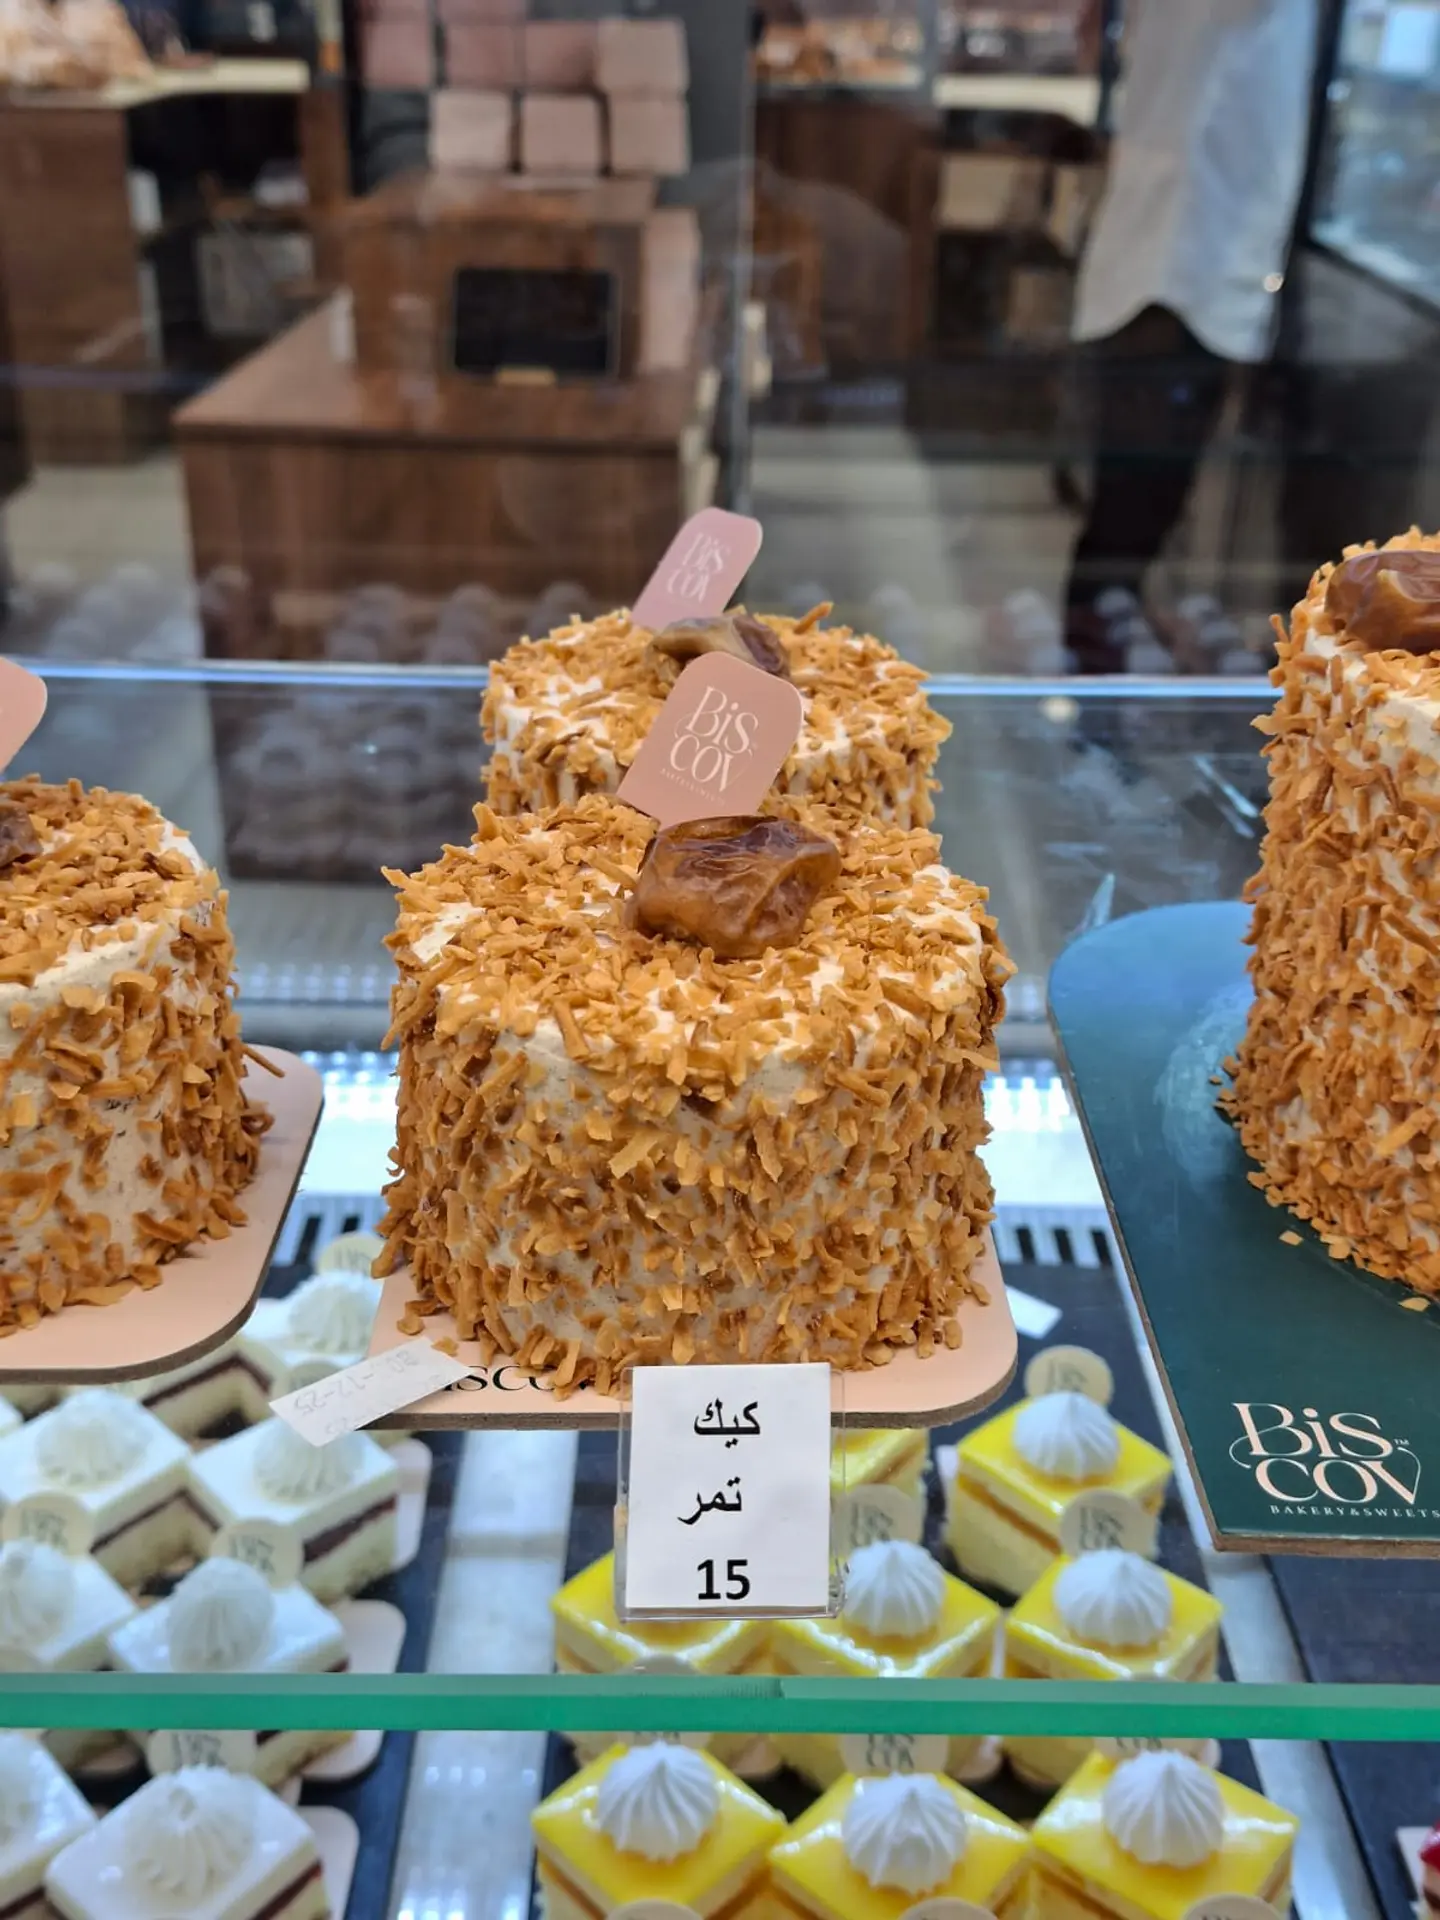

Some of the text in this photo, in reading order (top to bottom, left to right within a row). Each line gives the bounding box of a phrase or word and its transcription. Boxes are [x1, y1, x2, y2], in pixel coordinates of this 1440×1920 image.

[693, 1397, 761, 1449] كيك
[677, 1475, 743, 1526] تمر
[1255, 1456, 1421, 1505] COV
[696, 1558, 751, 1600] 15
